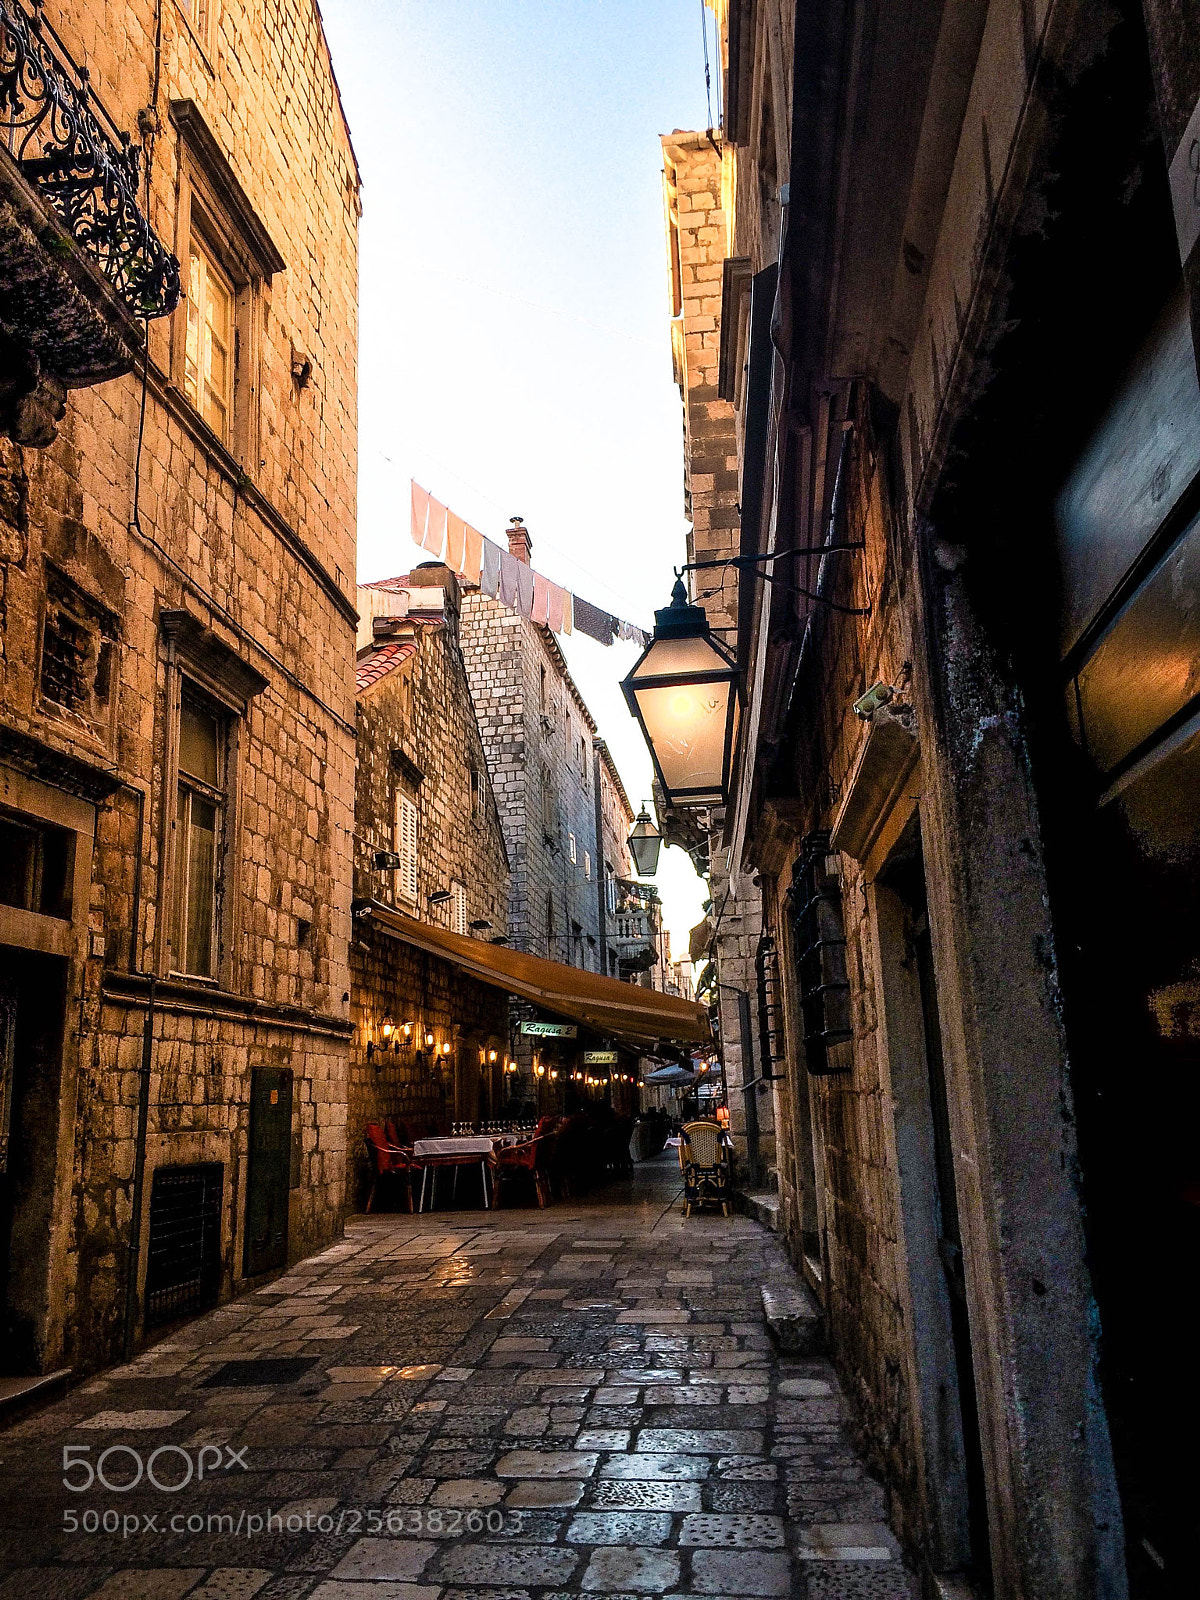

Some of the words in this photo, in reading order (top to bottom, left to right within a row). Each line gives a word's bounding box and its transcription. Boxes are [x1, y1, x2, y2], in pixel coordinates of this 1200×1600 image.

[525, 1023, 562, 1035] Ragusa
[565, 1026, 573, 1035] 2
[585, 1053, 610, 1062] Ragusa
